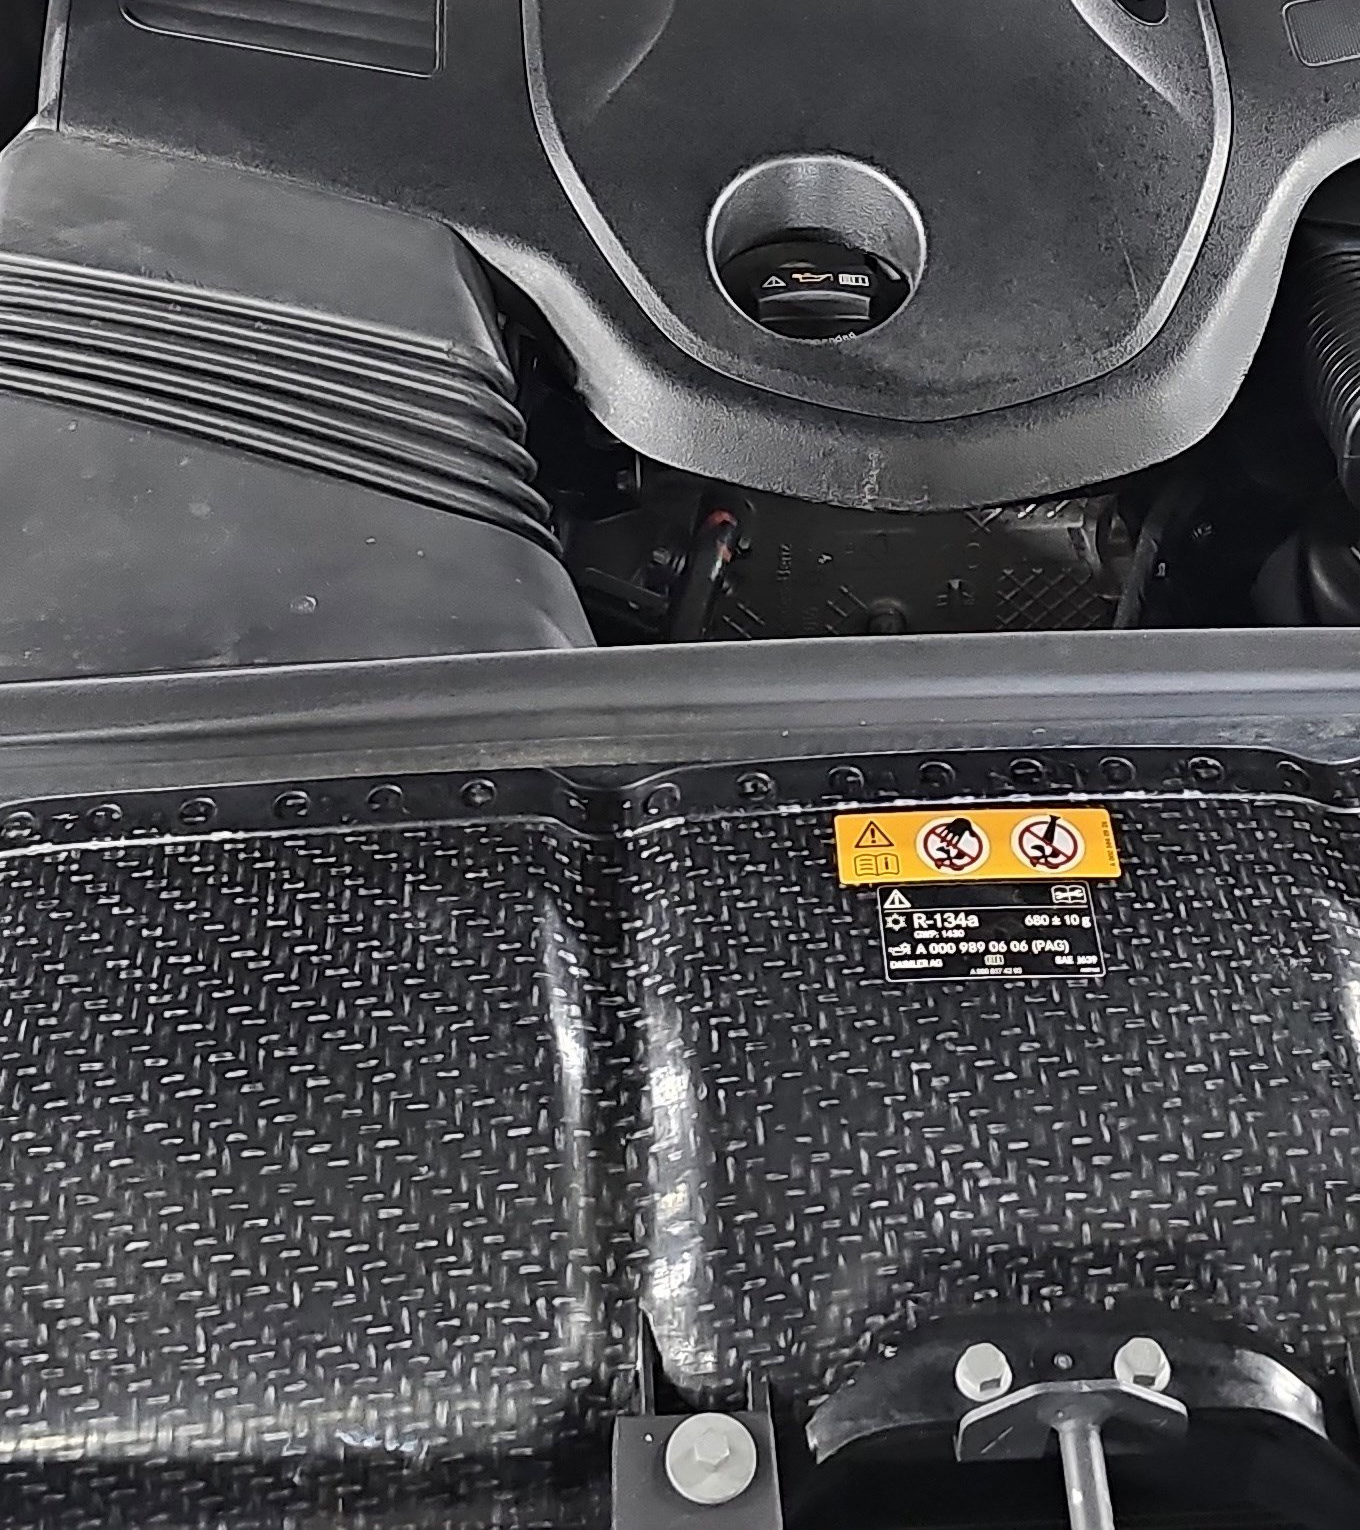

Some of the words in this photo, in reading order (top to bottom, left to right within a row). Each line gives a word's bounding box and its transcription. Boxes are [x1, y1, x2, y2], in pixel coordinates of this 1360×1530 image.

[912, 911, 980, 929] R-134a
[1024, 914, 1050, 926] 680
[1063, 913, 1080, 926] 10
[1081, 916, 1092, 928] g
[941, 928, 966, 938] 1430
[915, 942, 928, 955] A
[928, 942, 957, 954] 000
[958, 940, 986, 953] 989
[988, 940, 1008, 953] 06
[1009, 939, 1029, 952] 06
[1031, 939, 1070, 954] (PAG)
